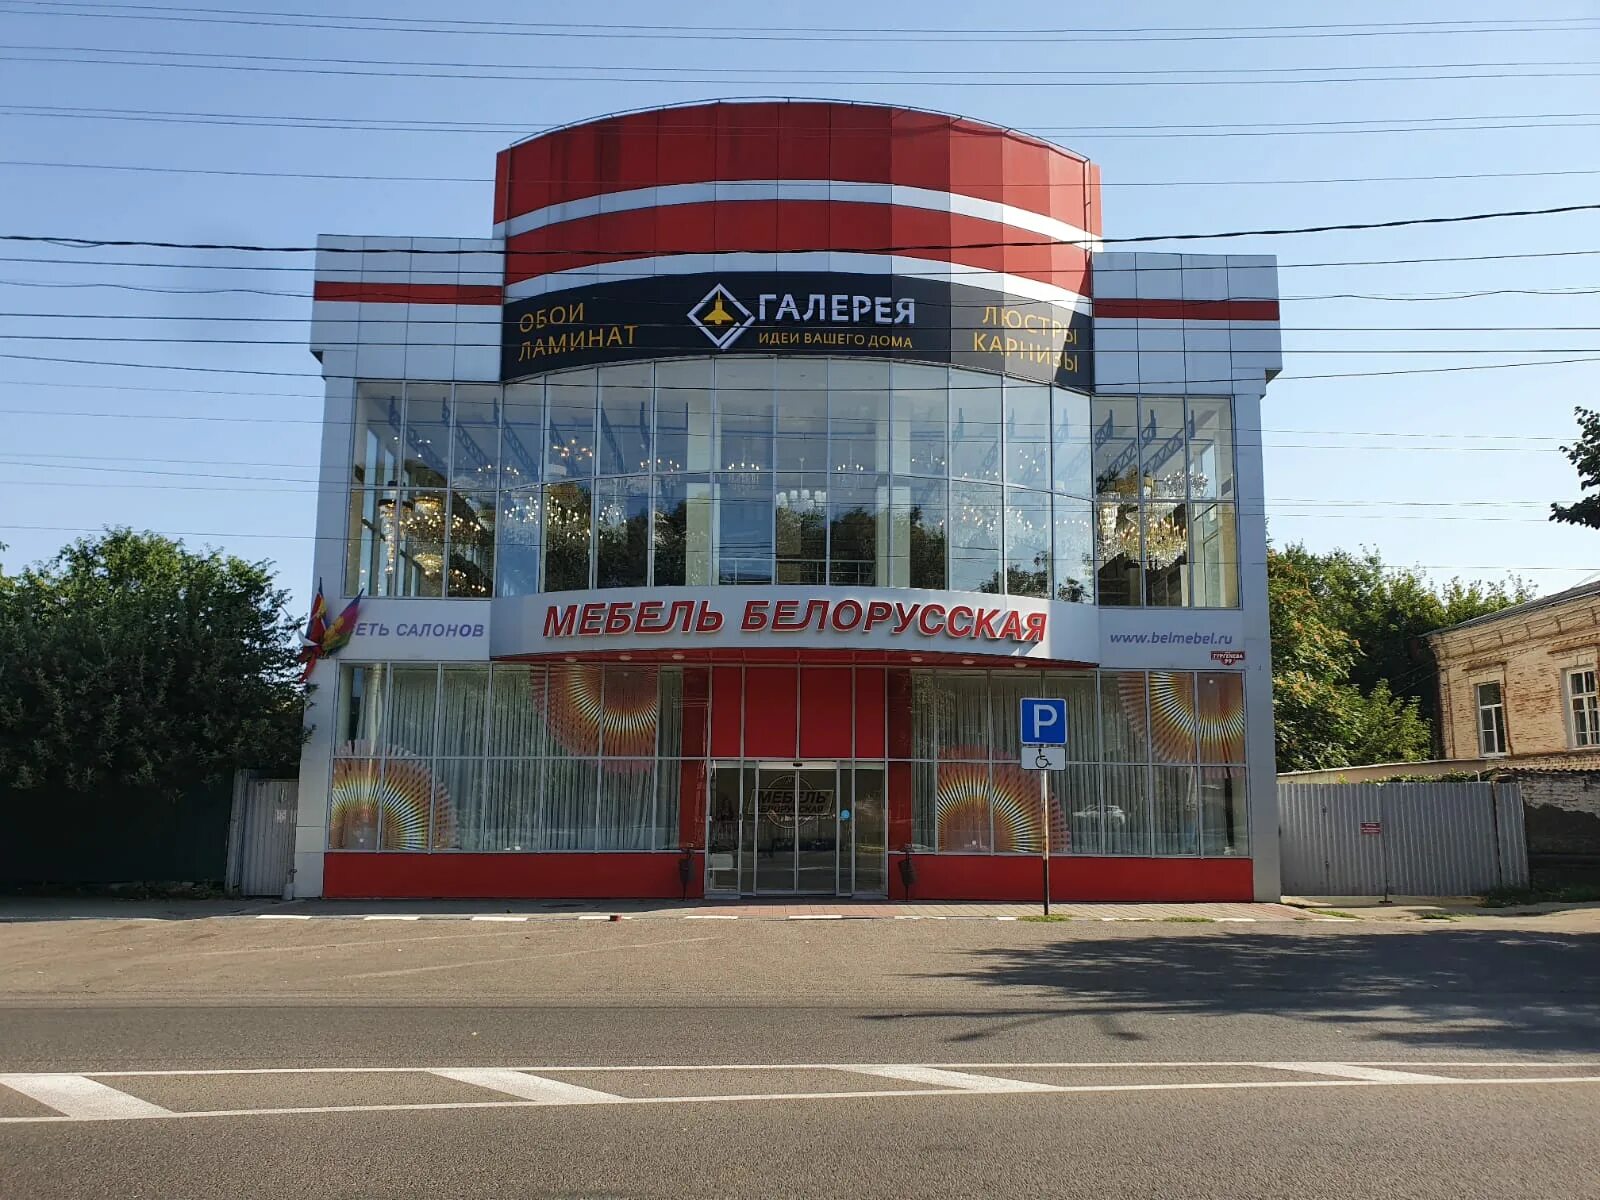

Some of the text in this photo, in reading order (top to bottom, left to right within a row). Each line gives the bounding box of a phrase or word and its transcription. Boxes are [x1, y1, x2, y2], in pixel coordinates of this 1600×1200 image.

[519, 302, 585, 333] ОБОИ
[758, 293, 916, 324] ГАЛЕРЕЯ
[981, 306, 1077, 344] ЛЮСТРЫ
[518, 325, 638, 362] ЛАМИНАТ
[759, 332, 912, 348] ИДЕИ ВАШЕГО ДОМА
[973, 332, 1078, 373] КАРНИЗЫ
[352, 622, 484, 638] ЕТЬ САЛОНОВ
[543, 599, 1048, 642] МЕБЕЛЬ БЕЛОРУССКАЯ
[1110, 632, 1233, 645] www.belmebel.ru
[1033, 704, 1058, 739] P
